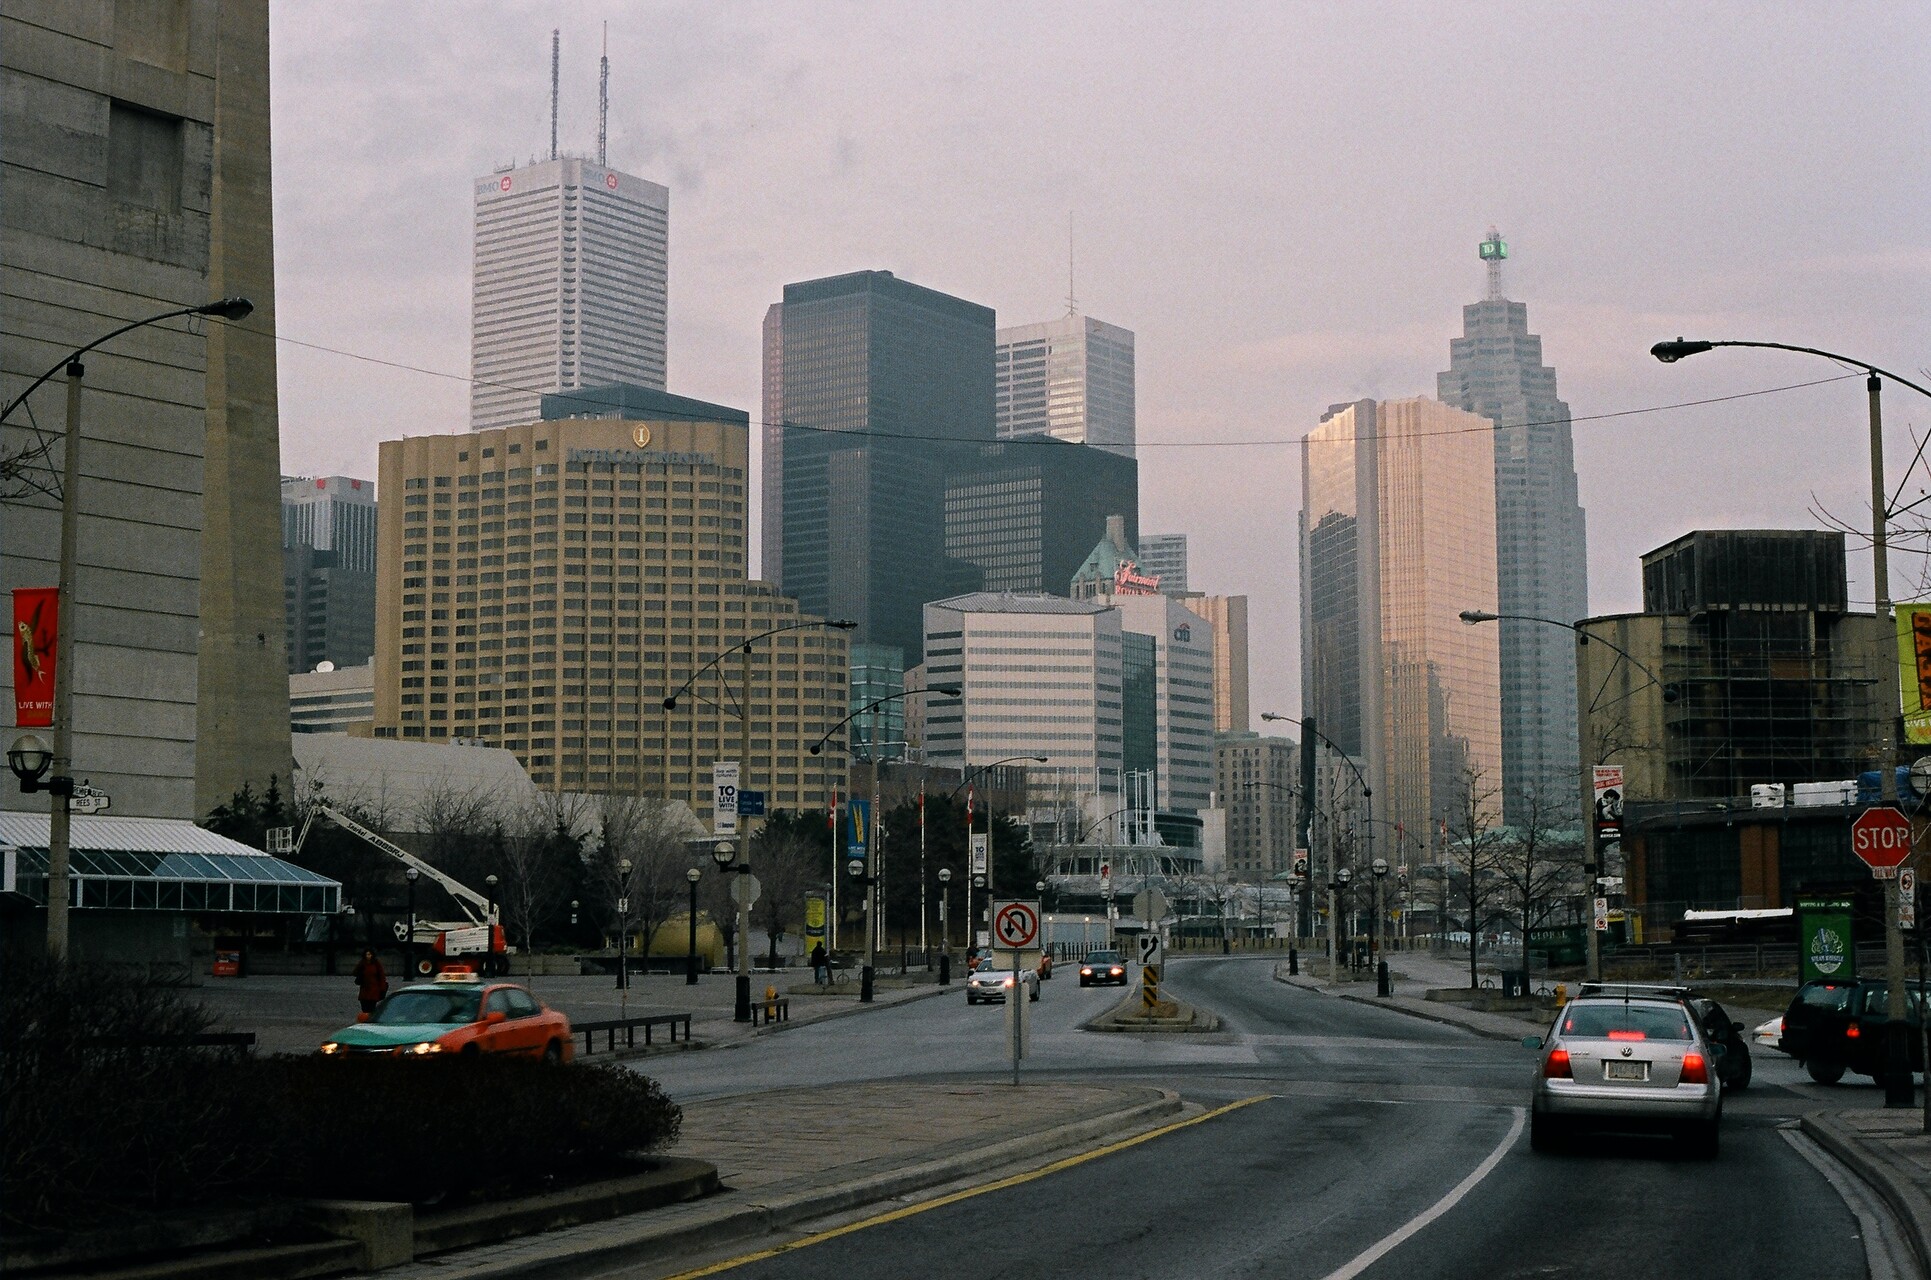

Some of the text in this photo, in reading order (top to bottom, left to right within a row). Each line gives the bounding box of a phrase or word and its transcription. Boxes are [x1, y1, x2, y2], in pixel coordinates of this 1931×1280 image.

[1114, 560, 1160, 592] Fairmont
[18, 701, 53, 709] LIVE WITH
[718, 785, 735, 796] TO
[76, 798, 101, 807] REES ST
[1857, 827, 1909, 849] STOP
